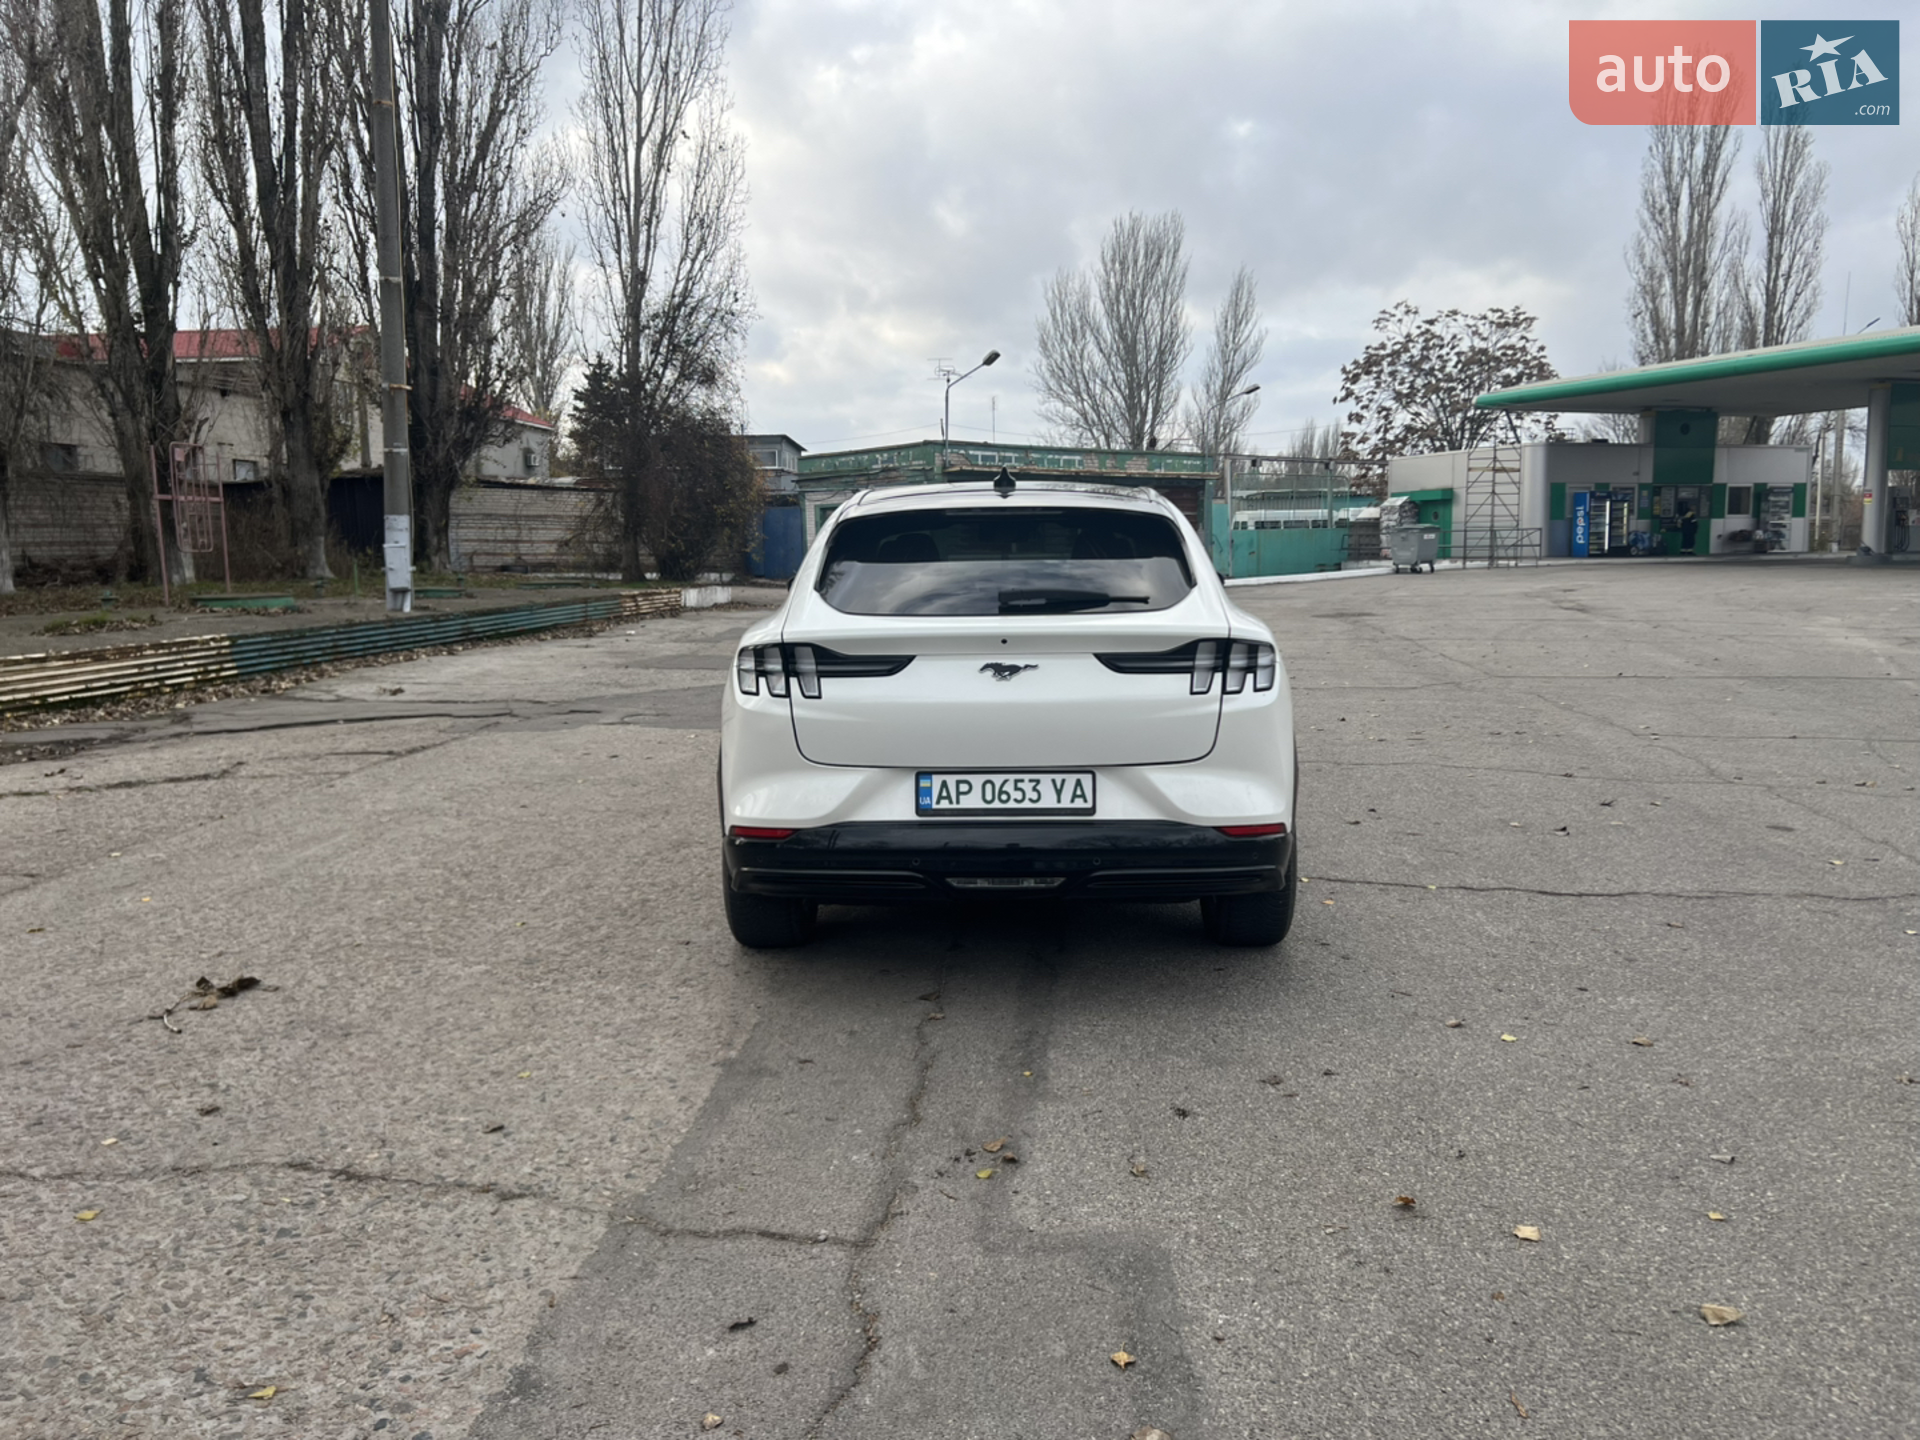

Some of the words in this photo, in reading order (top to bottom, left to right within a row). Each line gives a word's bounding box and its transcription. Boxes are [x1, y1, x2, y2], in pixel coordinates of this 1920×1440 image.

[1575, 505, 1586, 544] pepsi
[919, 796, 931, 805] UA
[935, 779, 973, 805] AP
[981, 778, 1042, 805] 0653
[1051, 778, 1088, 804] YA
